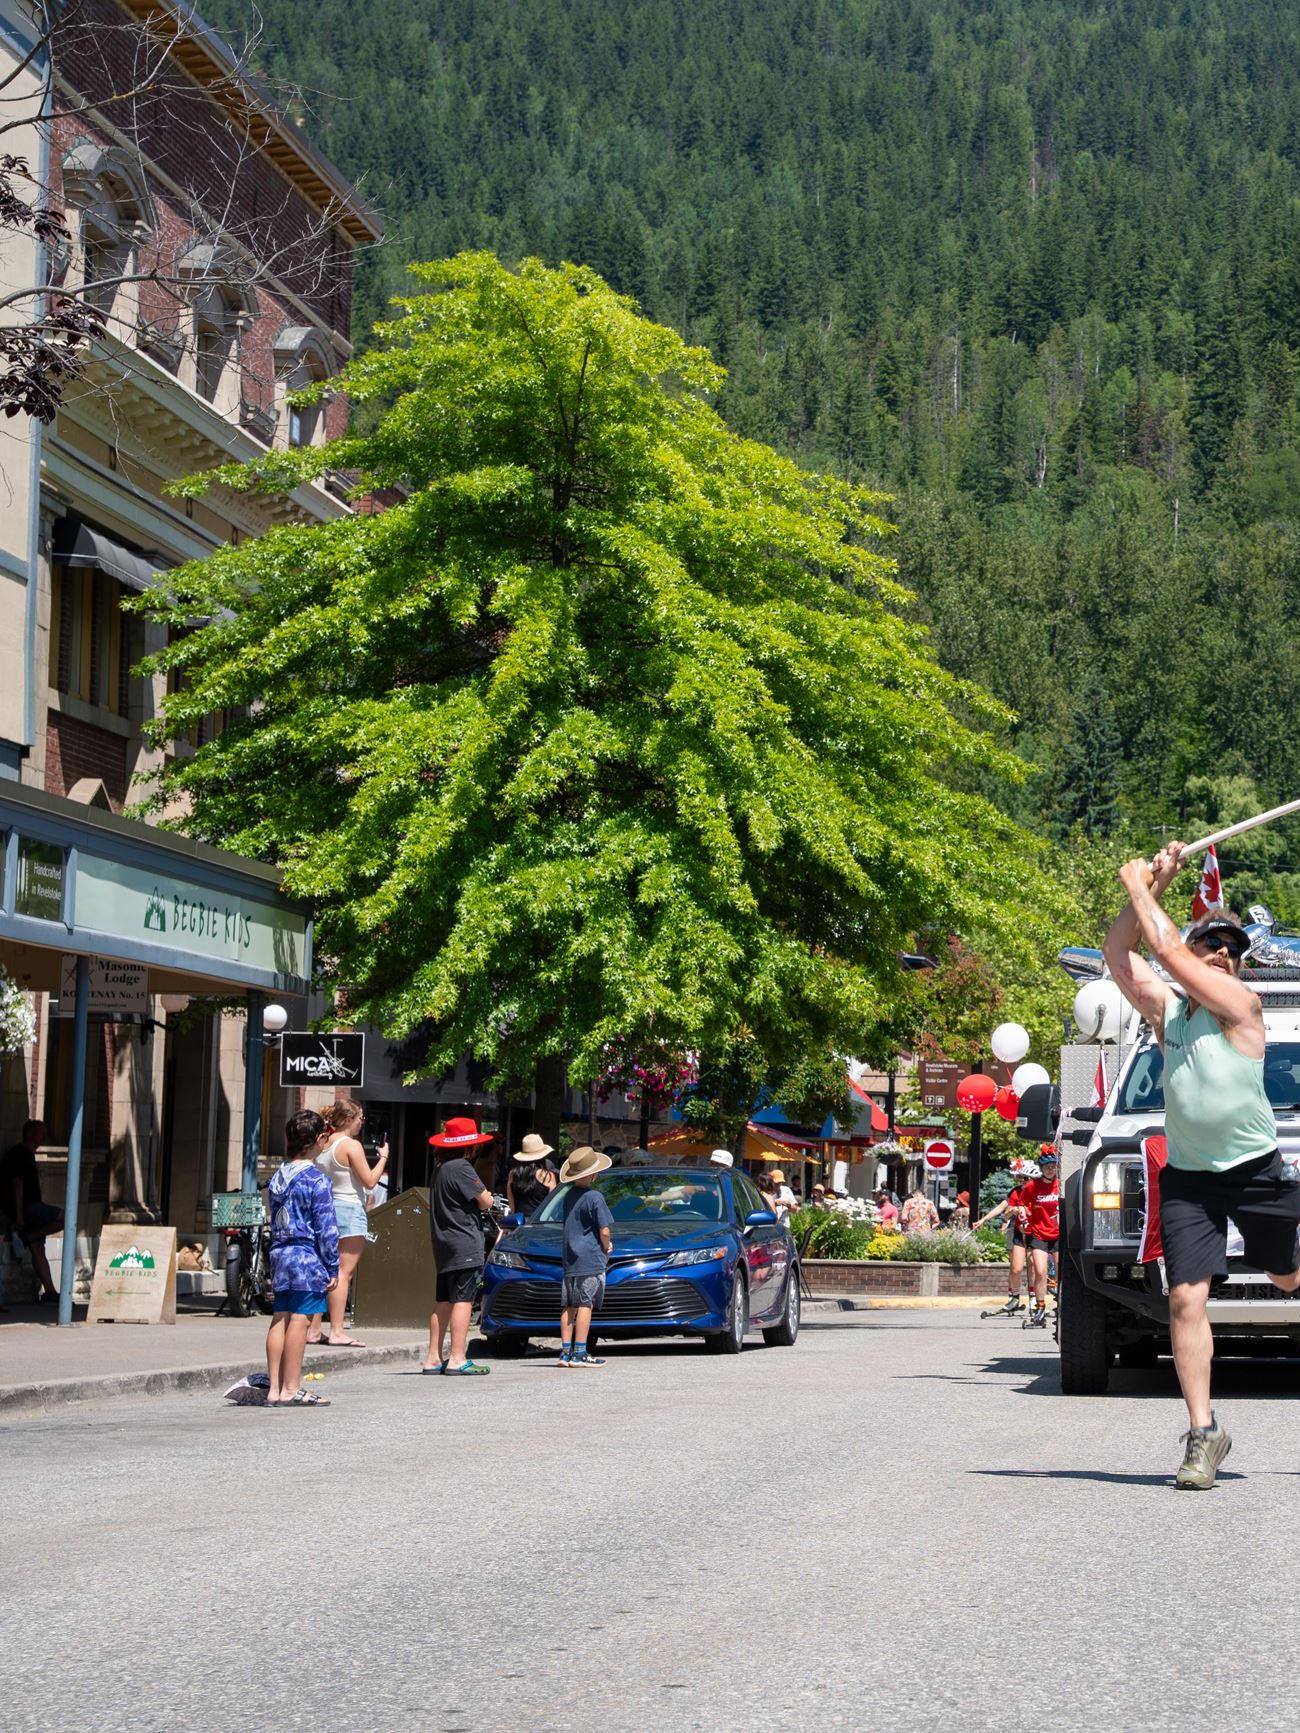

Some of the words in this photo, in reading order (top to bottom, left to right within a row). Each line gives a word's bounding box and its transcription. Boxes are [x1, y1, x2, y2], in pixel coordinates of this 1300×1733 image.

[34, 862, 61, 880] Handcrafted
[32, 882, 37, 895] in
[37, 883, 61, 900] Revelstoke
[173, 894, 218, 938] BEGBIE
[225, 907, 252, 948] KIDS
[104, 973, 140, 985] Lodge
[286, 1056, 331, 1072] MICA
